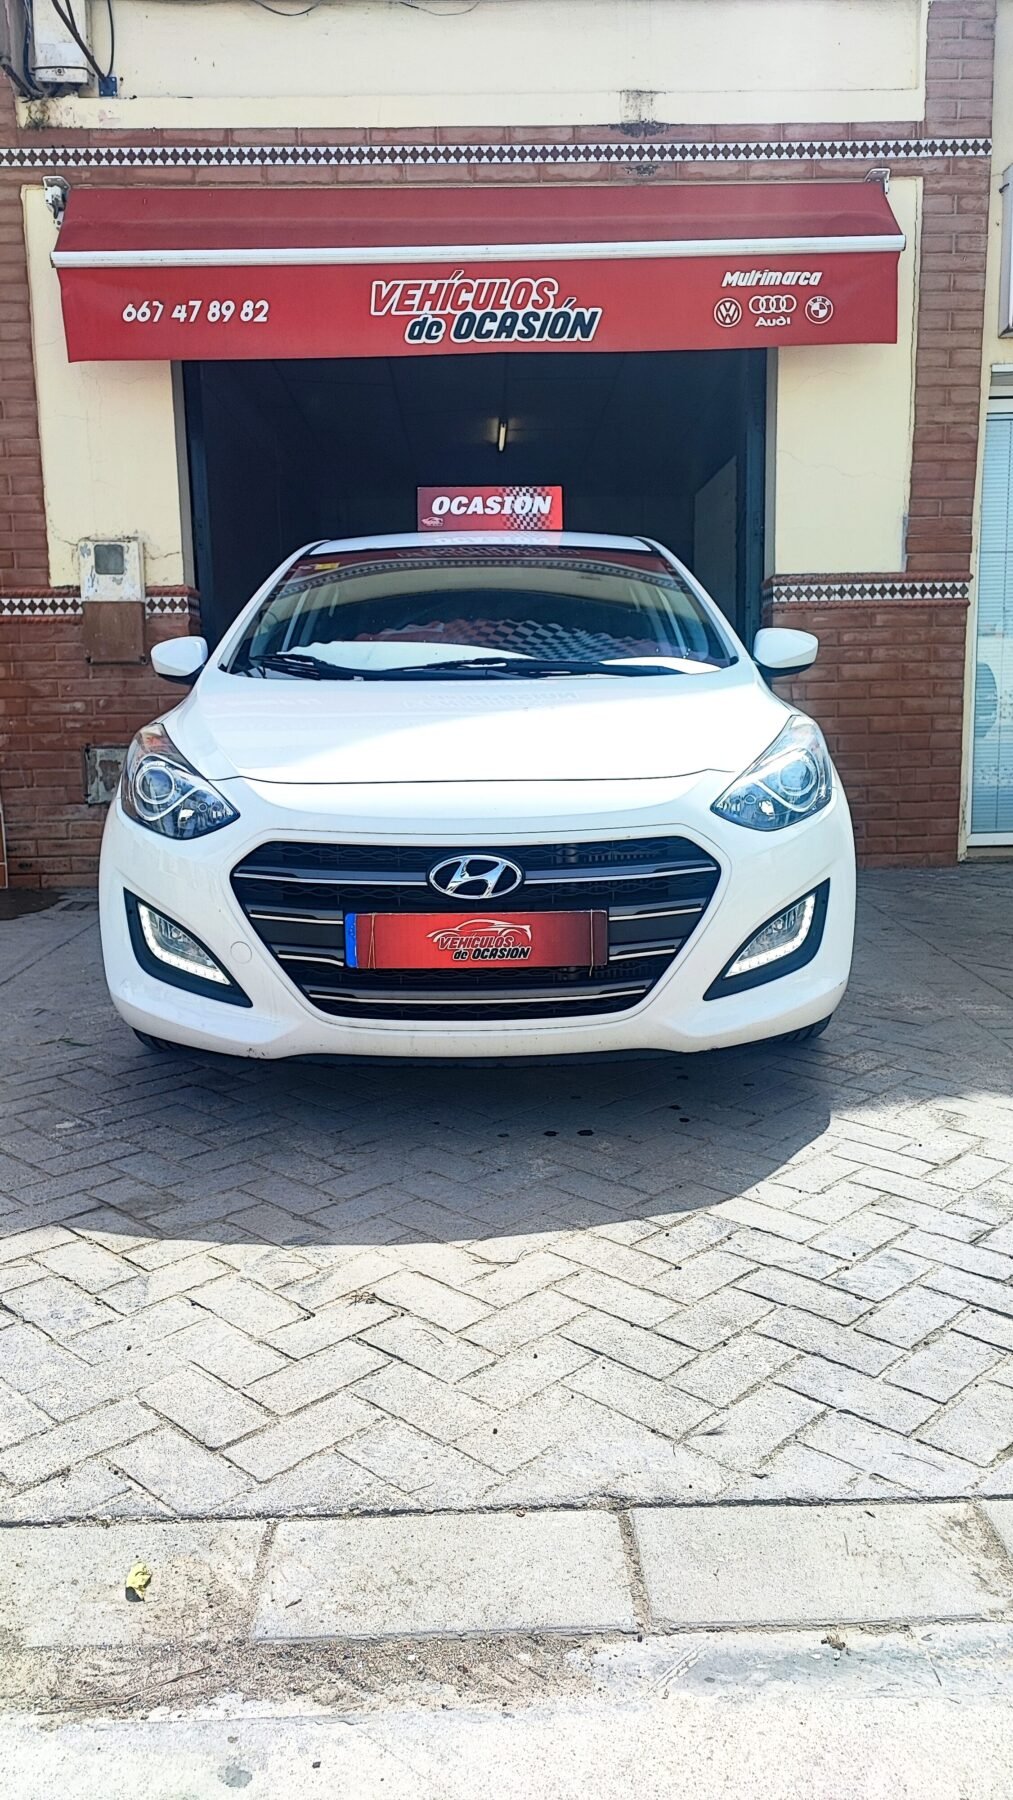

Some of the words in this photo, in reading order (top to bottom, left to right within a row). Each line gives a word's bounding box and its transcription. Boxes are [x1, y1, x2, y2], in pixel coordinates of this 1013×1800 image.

[721, 269, 823, 287] Multimarca
[371, 270, 559, 315] VEHÍCULOS
[122, 301, 164, 323] 667
[171, 300, 202, 323] 47
[207, 300, 235, 323] 89
[240, 300, 269, 323] 82
[404, 315, 446, 344] de
[453, 298, 602, 342] OCASIÓN
[755, 316, 791, 327] Audi
[453, 949, 469, 960] de
